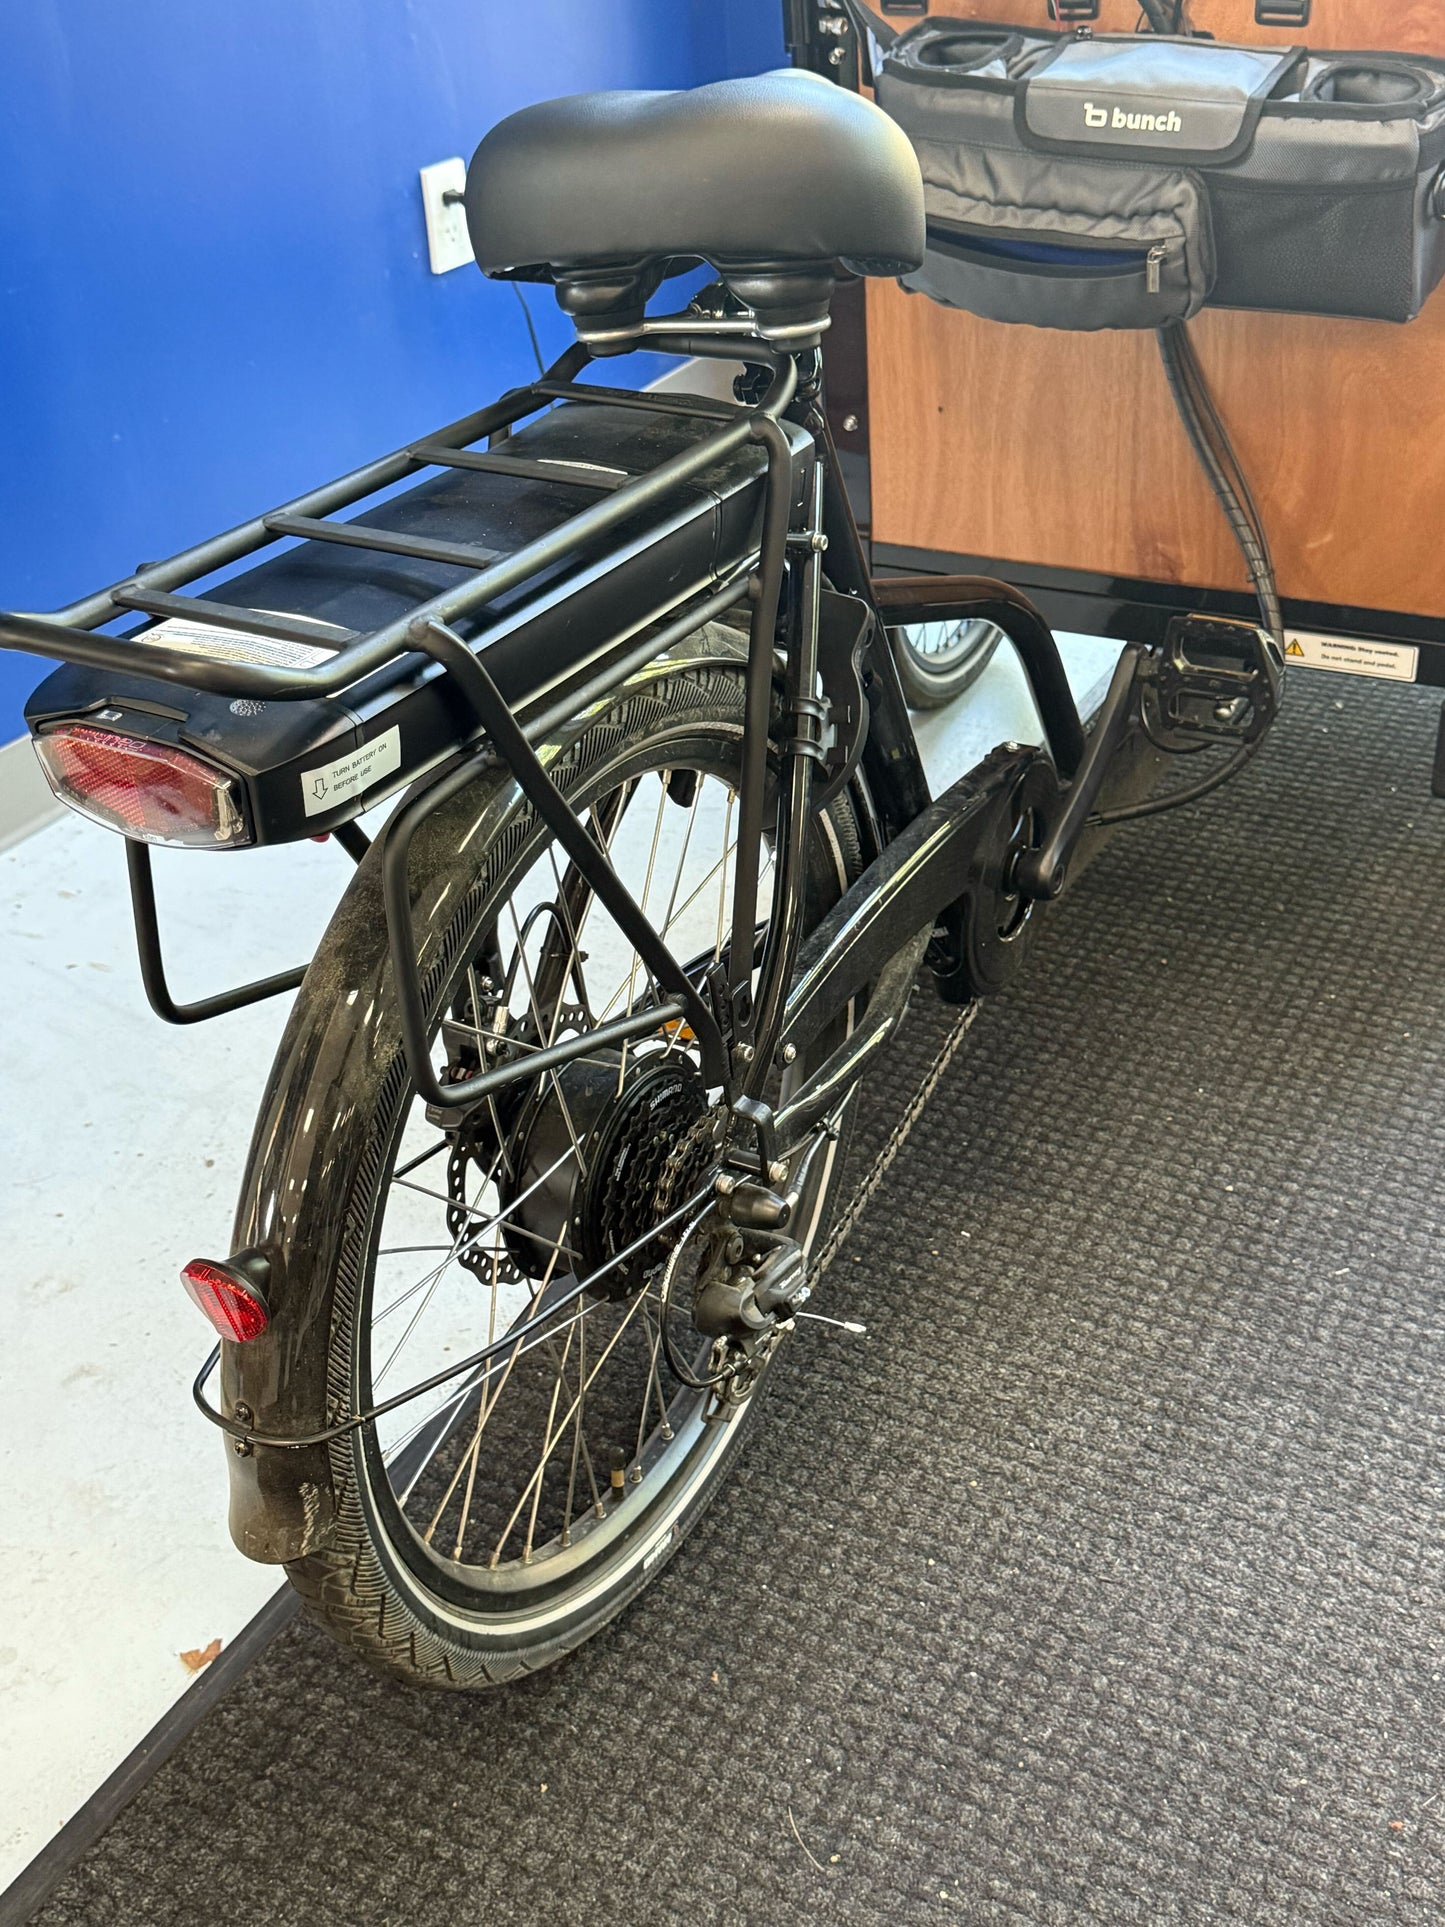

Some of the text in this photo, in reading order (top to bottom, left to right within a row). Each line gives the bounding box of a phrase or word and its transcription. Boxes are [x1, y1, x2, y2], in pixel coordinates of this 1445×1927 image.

[1111, 106, 1182, 132] bunch
[332, 742, 387, 778] TURN BATTERY ON
[333, 765, 372, 792] BEFORE USE
[650, 1083, 682, 1110] SHIMANO
